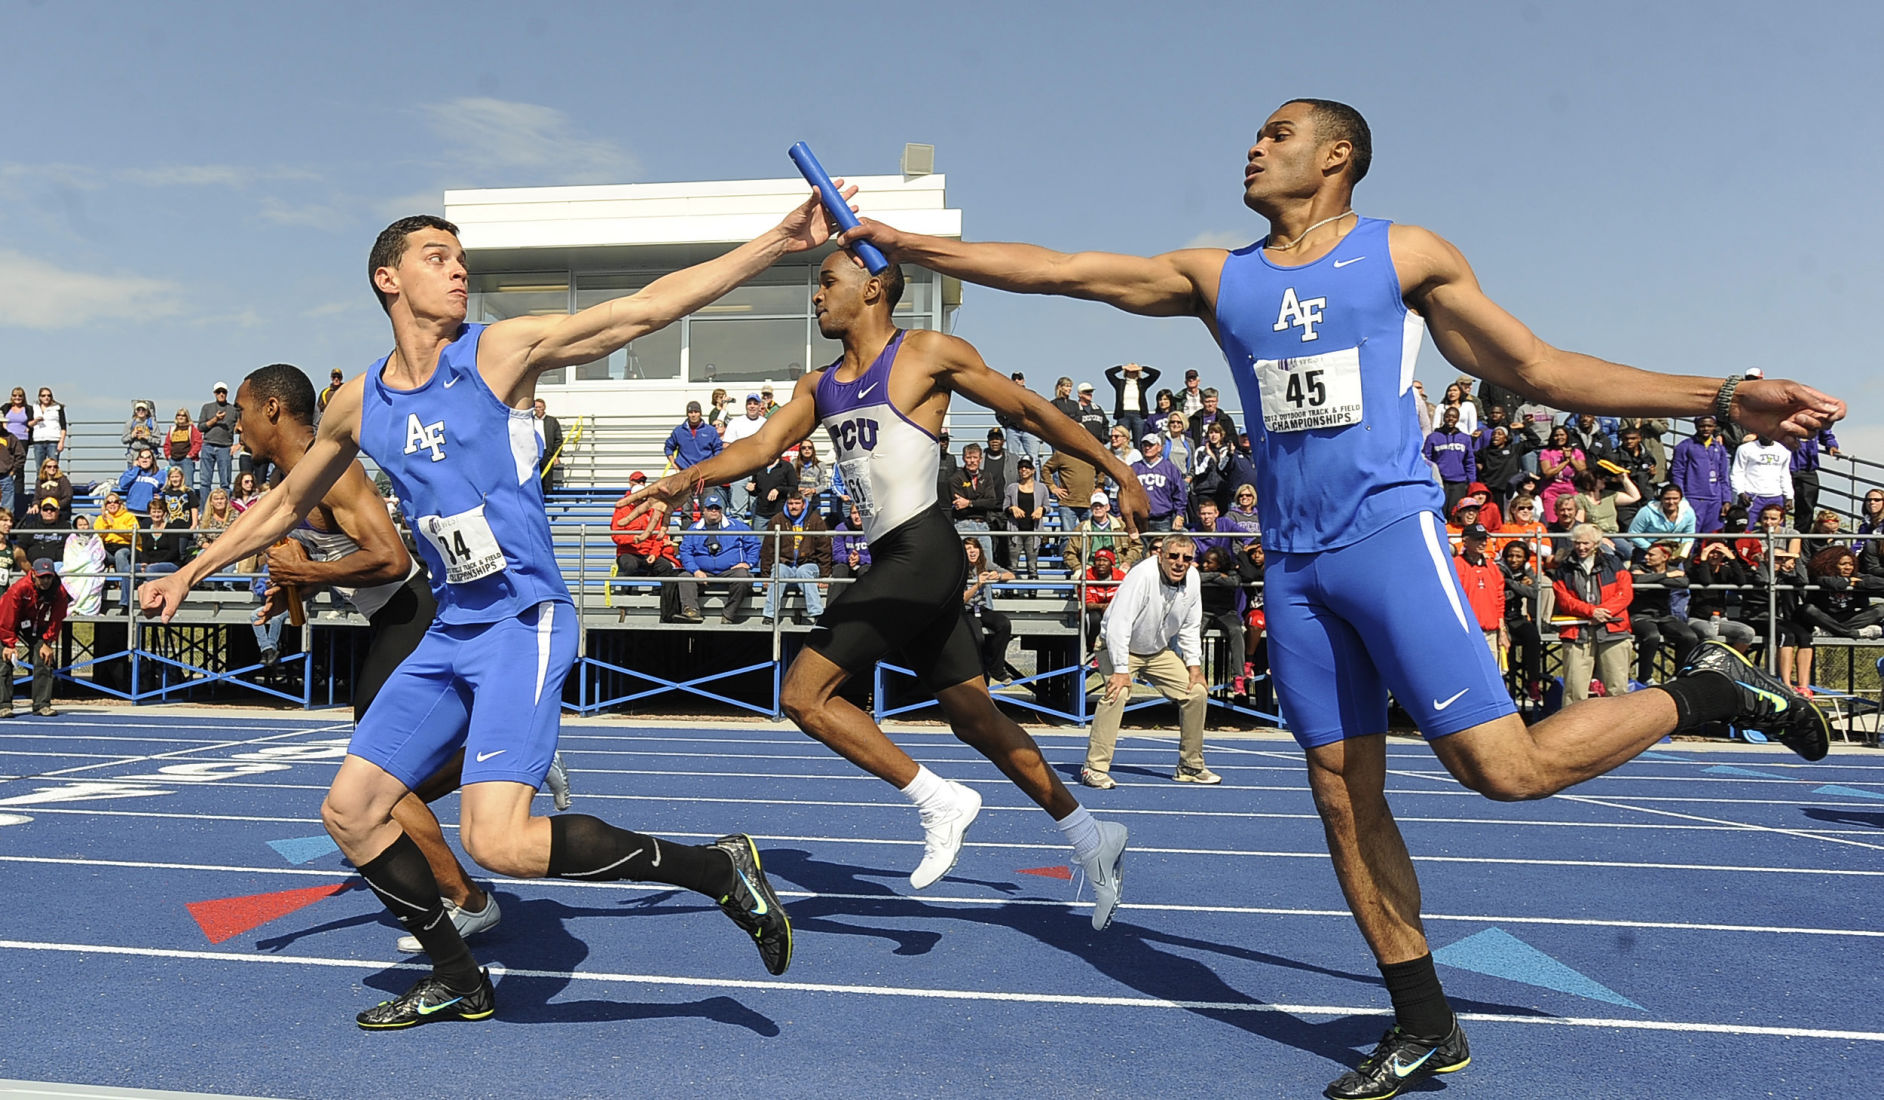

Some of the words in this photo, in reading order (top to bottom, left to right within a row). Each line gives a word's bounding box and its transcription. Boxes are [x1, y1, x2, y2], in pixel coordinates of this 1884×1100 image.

[1272, 287, 1327, 343] AF
[1286, 369, 1326, 409] 45
[1279, 411, 1306, 420] OUTDOOR
[1308, 407, 1329, 416] TRACK
[1340, 404, 1361, 412] FIELD
[1155, 417, 1168, 429] TC
[1272, 412, 1351, 432] CHAMPIONSHIPS
[403, 412, 447, 463] AF
[1137, 473, 1166, 487] TCU
[844, 477, 866, 503] 61
[854, 542, 868, 551] TC
[485, 552, 501, 563] FIELD
